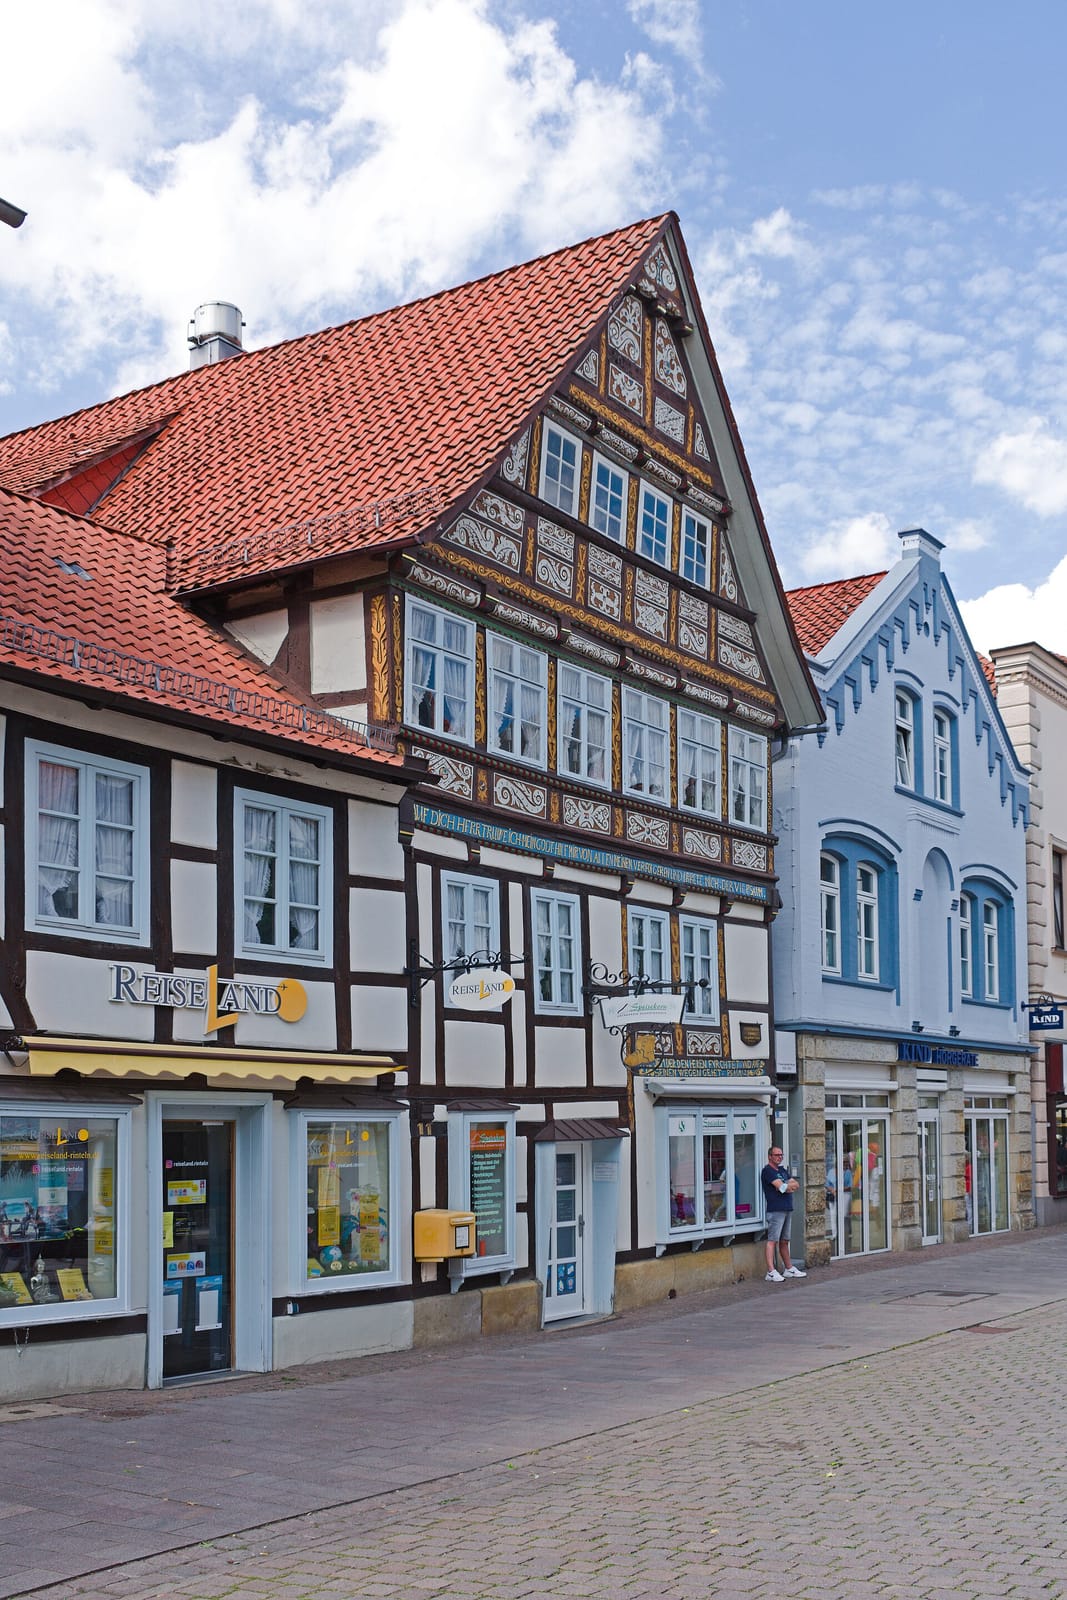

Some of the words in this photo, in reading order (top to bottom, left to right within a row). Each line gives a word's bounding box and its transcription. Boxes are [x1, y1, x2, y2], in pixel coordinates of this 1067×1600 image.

[430, 808, 454, 830] DICH
[1032, 1014, 1060, 1024] KIND
[901, 1042, 932, 1062] KIND
[417, 1122, 432, 1136] 11
